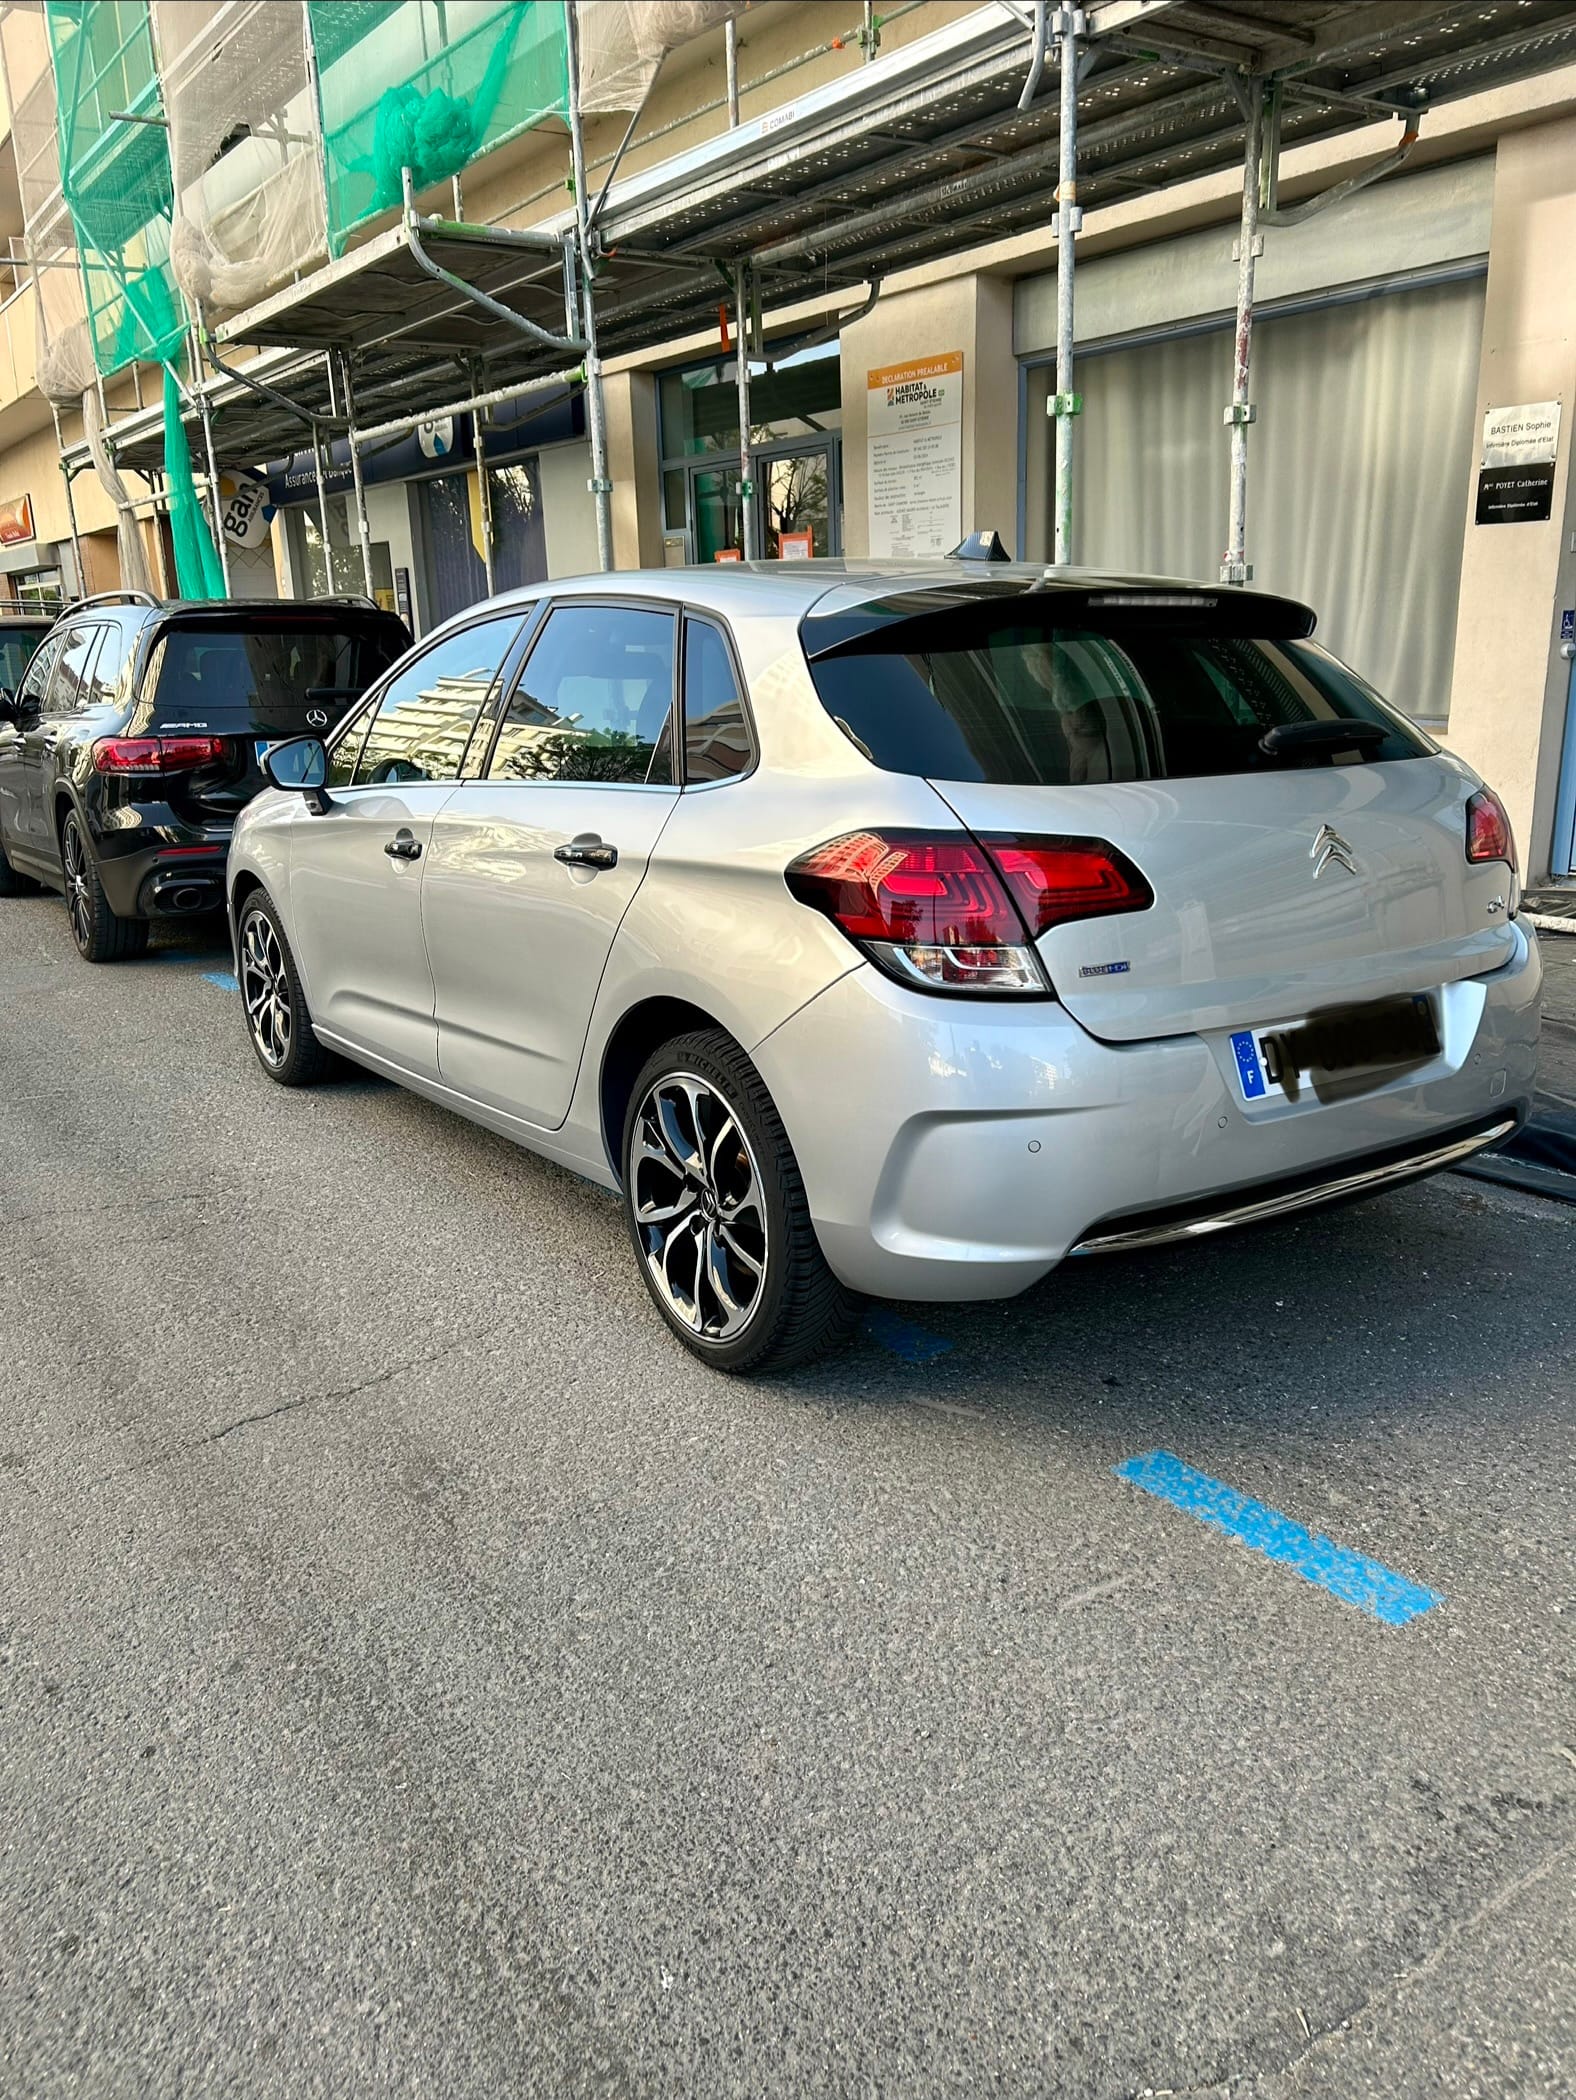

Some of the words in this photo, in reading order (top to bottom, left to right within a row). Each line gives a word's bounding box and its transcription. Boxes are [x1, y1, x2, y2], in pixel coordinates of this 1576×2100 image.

[917, 363, 948, 377] PREALABLE
[895, 382, 923, 395] HABITAT
[1525, 420, 1551, 431] Sophie
[284, 471, 318, 489] Assurance
[1516, 478, 1548, 488] Catherine
[223, 482, 259, 538] gan
[1246, 1070, 1255, 1084] F
